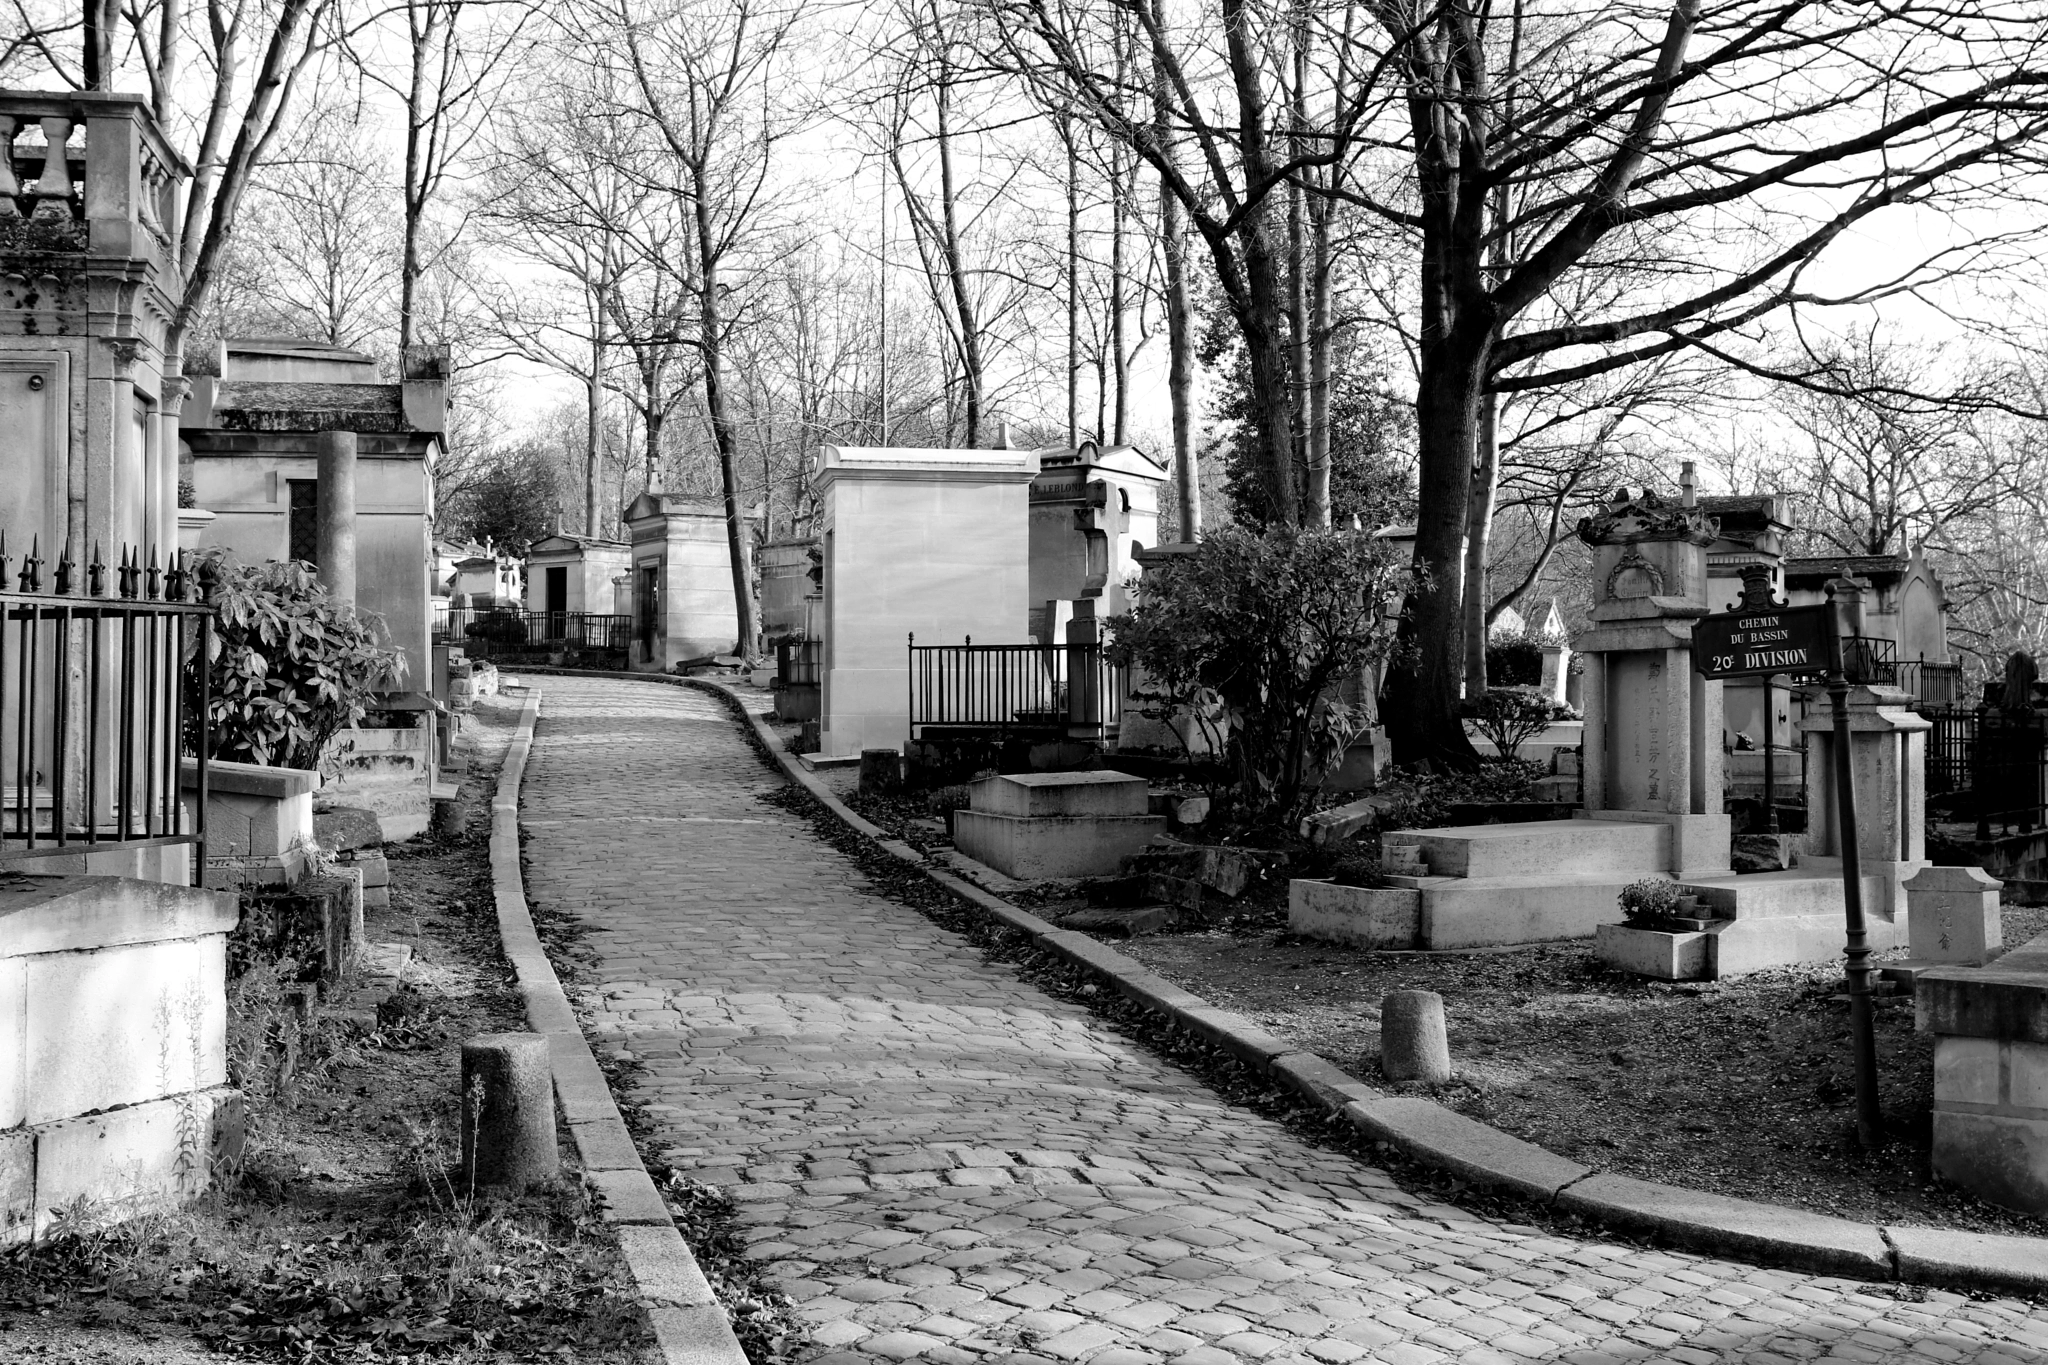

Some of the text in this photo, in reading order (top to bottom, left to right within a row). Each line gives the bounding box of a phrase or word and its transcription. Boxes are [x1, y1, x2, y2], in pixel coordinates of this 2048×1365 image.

[1738, 616, 1780, 630] CHEMIN
[1730, 629, 1789, 645] DU BASSIN
[1744, 648, 1808, 669] DIVISION
